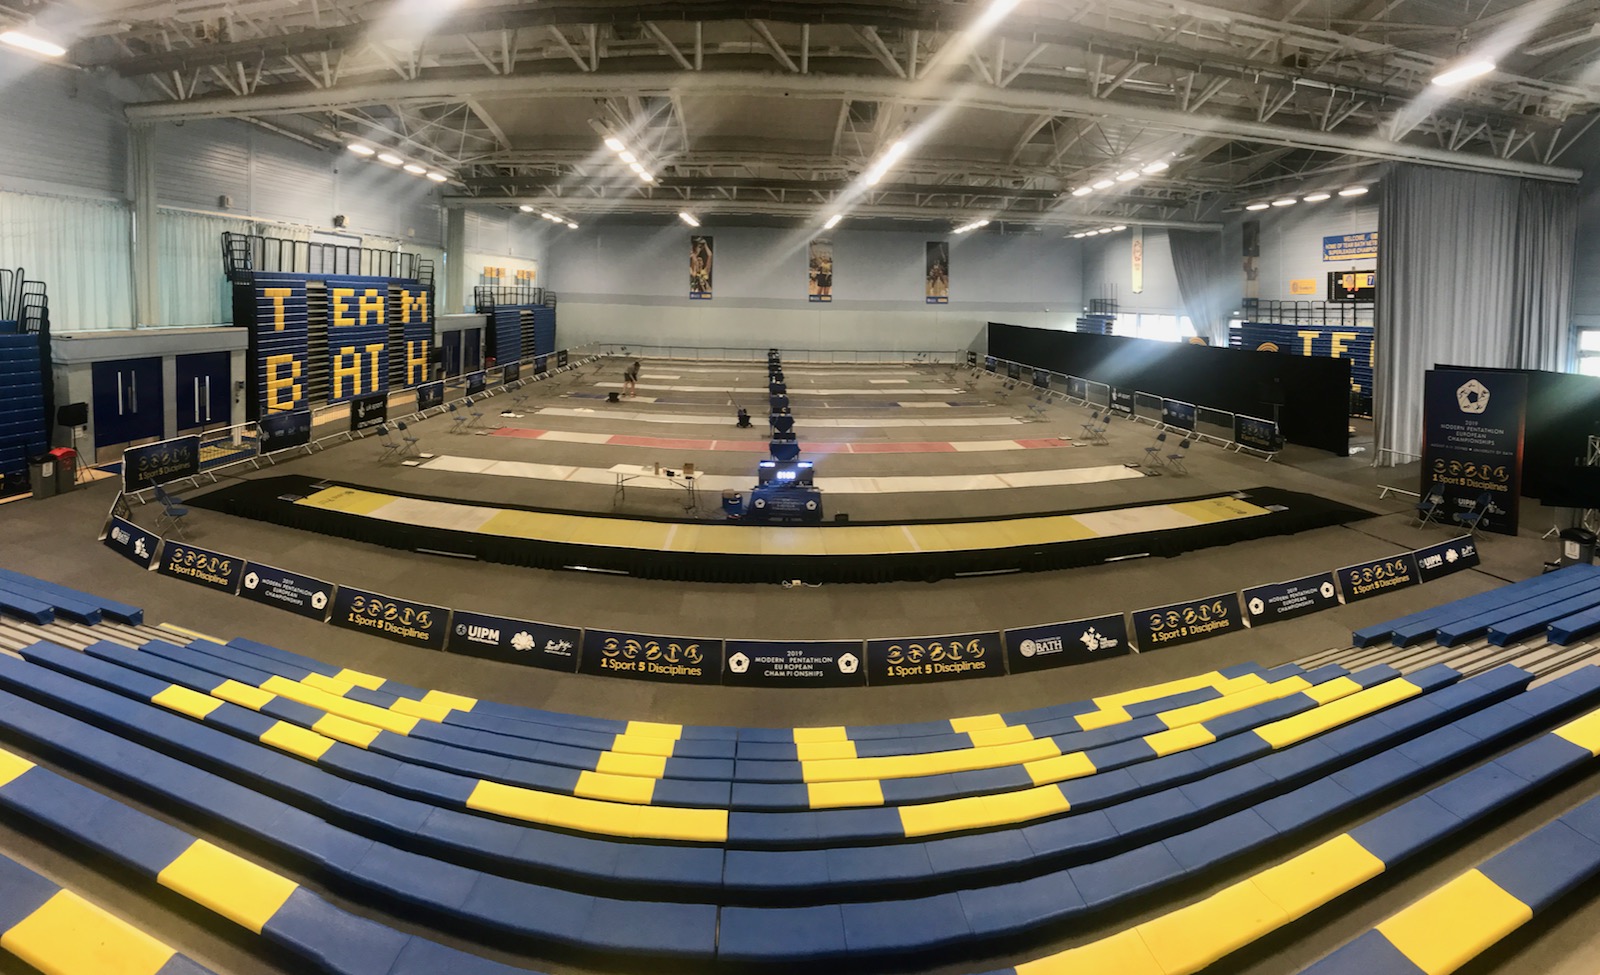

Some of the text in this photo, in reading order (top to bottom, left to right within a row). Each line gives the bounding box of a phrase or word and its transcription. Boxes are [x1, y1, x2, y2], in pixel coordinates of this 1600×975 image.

[264, 288, 427, 331] TEAM
[267, 340, 427, 414] BATH
[1456, 431, 1486, 439] EUROPEAN
[1466, 426, 1504, 435] PENTATHLON
[1448, 436, 1495, 446] CHAMPIONSHIPS
[1439, 474, 1459, 485] Sport
[1467, 479, 1508, 492] Disciplines
[1424, 554, 1442, 566] UIPM
[169, 562, 228, 586] 1 Sport 5 Disciplines
[262, 578, 313, 597] MODERN PENTATHLON
[273, 587, 298, 598] EUROPEAN
[1353, 575, 1410, 594] 1 Sport 5 Disciplines
[265, 590, 303, 606] CHAMPIONSHIPS
[1268, 588, 1318, 604] MODERN PENTATHLON
[1282, 596, 1307, 606] EUROPEAN
[1277, 600, 1314, 613] CHAMPIONSHIPS
[348, 613, 430, 641] 1 Sport 5 Disciplines
[468, 625, 500, 641] UIPM
[1152, 619, 1229, 642] 1 Sport 5 Disciplines
[1036, 640, 1063, 652] BATH
[601, 658, 702, 676] 1 Sport 5 Disciplines
[887, 661, 986, 676] 1 Sport 5 Disciplines
